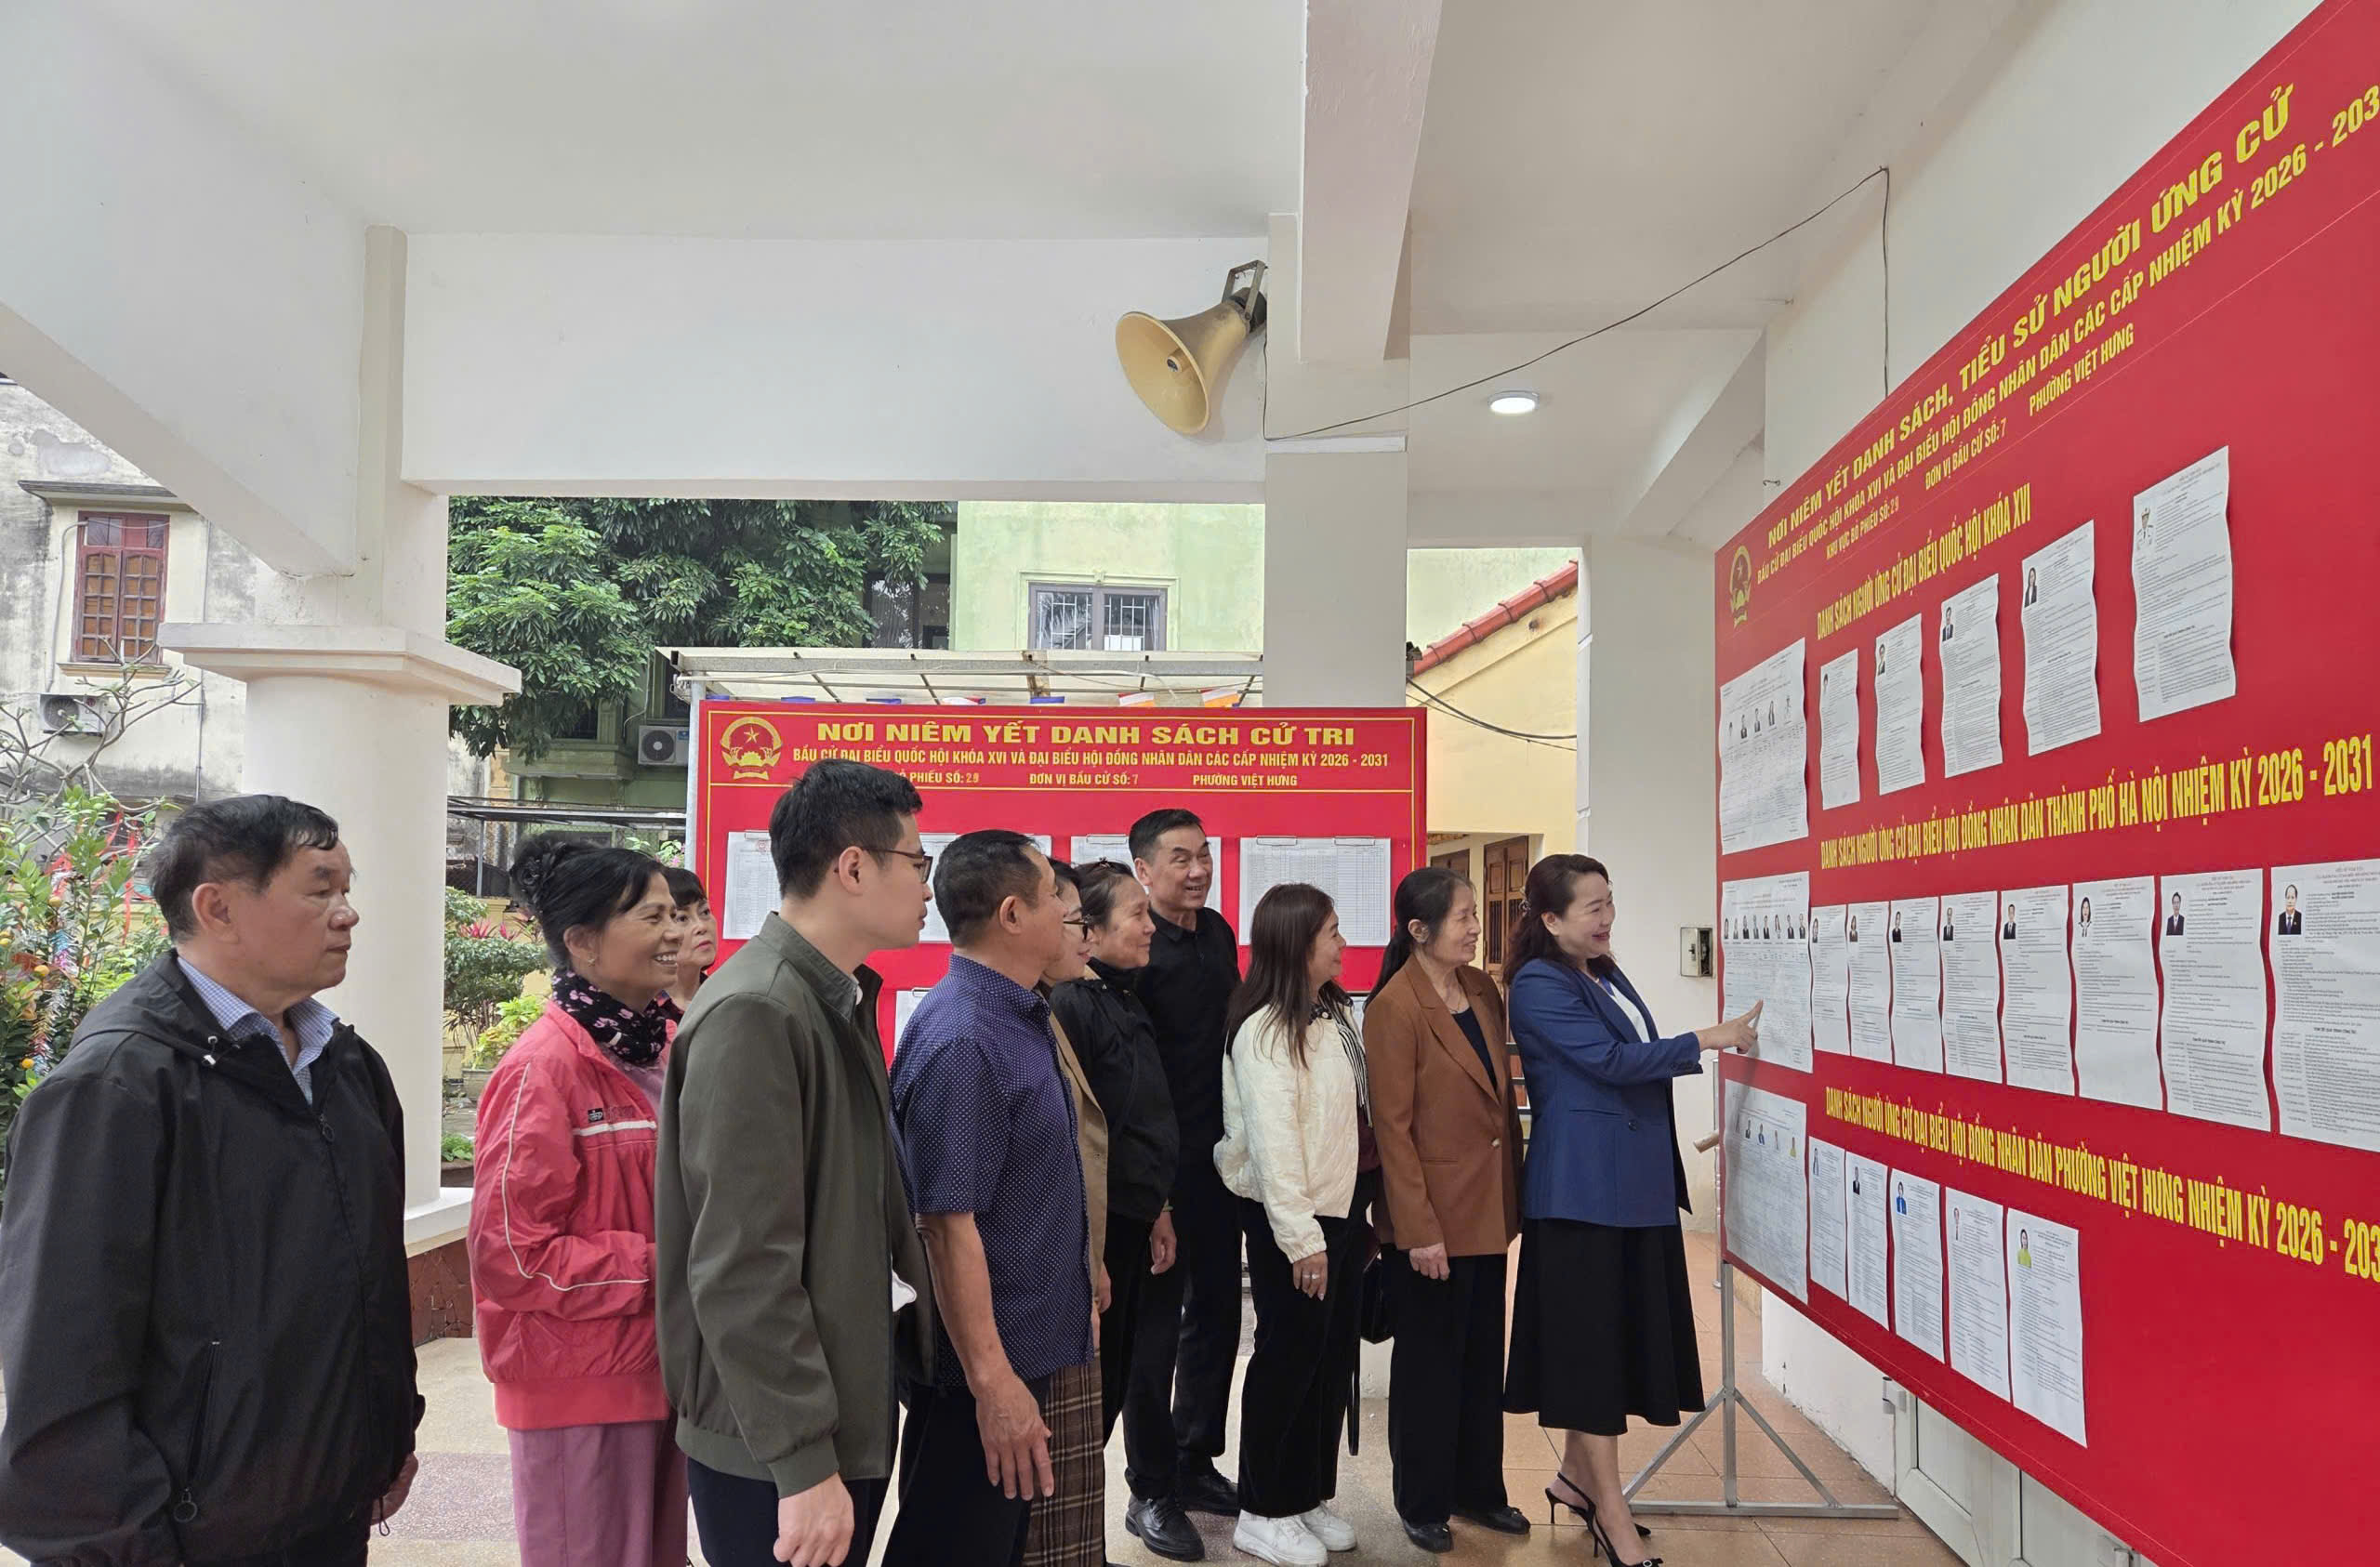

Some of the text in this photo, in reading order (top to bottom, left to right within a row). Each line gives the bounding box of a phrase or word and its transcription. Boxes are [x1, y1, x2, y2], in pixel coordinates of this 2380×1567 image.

[1768, 82, 2294, 548] NƠI NIÊM YẾT DANH SÁCH, TIỂU SỬ NGƯỜI ỨNG CỬ
[1770, 551, 1780, 574] CỬ
[1779, 546, 1791, 567] ĐẠI
[1792, 531, 1807, 559] BIỂU
[1808, 516, 1828, 546] QUỐC
[1829, 506, 1842, 531] HỘI
[1844, 491, 1865, 520] KHÓA
[1867, 476, 1882, 502] XVI
[1884, 465, 1896, 490] VÀ
[1897, 452, 1912, 479] ĐẠI
[1916, 428, 1938, 465] BIỂU
[1942, 415, 1960, 444] HỘI
[1999, 355, 2036, 402] NHÂN
[2040, 328, 2070, 371] DÂN
[2074, 301, 2105, 343] CÁC
[2110, 269, 2144, 316] CẤP
[2149, 216, 2211, 288] NHIỆM
[2217, 188, 2243, 235] KỲ
[2251, 143, 2307, 210] 2026
[2332, 85, 2380, 148] 203
[1826, 539, 1838, 560] KHU
[1839, 531, 1850, 553] VỰC
[1850, 520, 1859, 543] BỎ
[1860, 507, 1878, 536] PHIẾU
[1879, 497, 1890, 522] SỐ:
[1925, 466, 1941, 491] ĐƠN
[1943, 456, 1950, 479] VỊ
[1971, 429, 1983, 458] CỬ
[1985, 416, 1999, 448] SỐ:
[2001, 418, 2007, 437] 7
[2030, 368, 2071, 416] PHƯỜNG
[2074, 348, 2097, 383] VIỆT
[2101, 323, 2134, 364] HƯNG
[1818, 482, 2030, 640] DANH SÁCH NGƯỜI ỨNG CỬ ĐẠI BIỂU QUỐC HỘI KHÓA XVI
[817, 719, 1354, 745] NƠI NIÊM YẾT DANH SÁCH CỬ TRI
[864, 744, 891, 762] BIỂU
[894, 745, 926, 764] QUỐC
[930, 747, 948, 766] HỘI
[953, 748, 985, 764] KHÓA
[988, 751, 1007, 764] XVI
[1011, 748, 1025, 764] VÀ
[1029, 751, 1049, 767] ĐẠI
[1052, 746, 1078, 765] BIỂU
[1083, 750, 1103, 768] HỘI
[1142, 750, 1174, 765] NHÂN
[1178, 750, 1202, 766] DÂN
[1206, 750, 1229, 766] CÁC
[1233, 749, 1256, 766] CẤP
[1260, 750, 1298, 769] NHIỆM
[1302, 751, 1317, 766] KỲ
[1320, 754, 1348, 767] 2026
[1360, 754, 1388, 767] 2031
[910, 769, 942, 783] PHIẾU
[945, 770, 964, 784] SỐ:
[1030, 772, 1051, 784] ĐƠN
[1056, 773, 1065, 786] VỊ
[1095, 770, 1111, 784] CỬ
[1113, 770, 1130, 784] SỐ:
[1132, 774, 1139, 784] 7
[1193, 773, 1237, 786] PHƯỜNG
[1241, 773, 1264, 788] VIỆT
[1267, 774, 1298, 786] HƯNG
[1821, 839, 1837, 869] DANH
[1838, 831, 1856, 867] SÁCH
[1857, 824, 1878, 864] NGƯỜI
[1879, 823, 1894, 862] ỨNG
[1896, 814, 1906, 860] CỬ
[1908, 823, 1921, 864] ĐẠI
[1923, 805, 1942, 855] BIỂU
[1944, 809, 1959, 860] HỘI
[1962, 800, 1987, 849] ĐỒNG
[1990, 797, 2018, 846] NHÂN
[2020, 792, 2043, 841] DÂN
[2046, 785, 2086, 836] THÀNH
[2089, 768, 2115, 831] PHỐ
[2120, 770, 2139, 827] HÀ
[2142, 766, 2167, 832] NỘI
[2172, 756, 2226, 825] NHIỆM
[2230, 746, 2252, 810] KỲ
[2257, 748, 2303, 807] 2026
[2323, 733, 2373, 797] 2031
[1826, 1086, 1843, 1119] DANH
[1844, 1086, 1861, 1126] SÁCH
[1862, 1092, 1884, 1133] NGƯỜI
[1884, 1096, 1900, 1138] ỨNG
[1902, 1096, 1912, 1141] CỬ
[1913, 1110, 1927, 1153] ĐẠI
[1929, 1101, 1950, 1152] BIỂU
[1951, 1113, 1966, 1165] HỘI
[1968, 1113, 1995, 1166] ĐỒNG
[1997, 1126, 2027, 1176] NHÂN
[2029, 1132, 2053, 1184] DÂN
[2055, 1141, 2106, 1200] PHƯỜNG
[2109, 1152, 2138, 1218] VIỆT
[2142, 1166, 2184, 1224] HƯNG
[2188, 1175, 2243, 1247] NHIỆM
[2247, 1185, 2270, 1250] KỲ
[2276, 1202, 2323, 1266] 2026
[2344, 1218, 2380, 1284] 203
